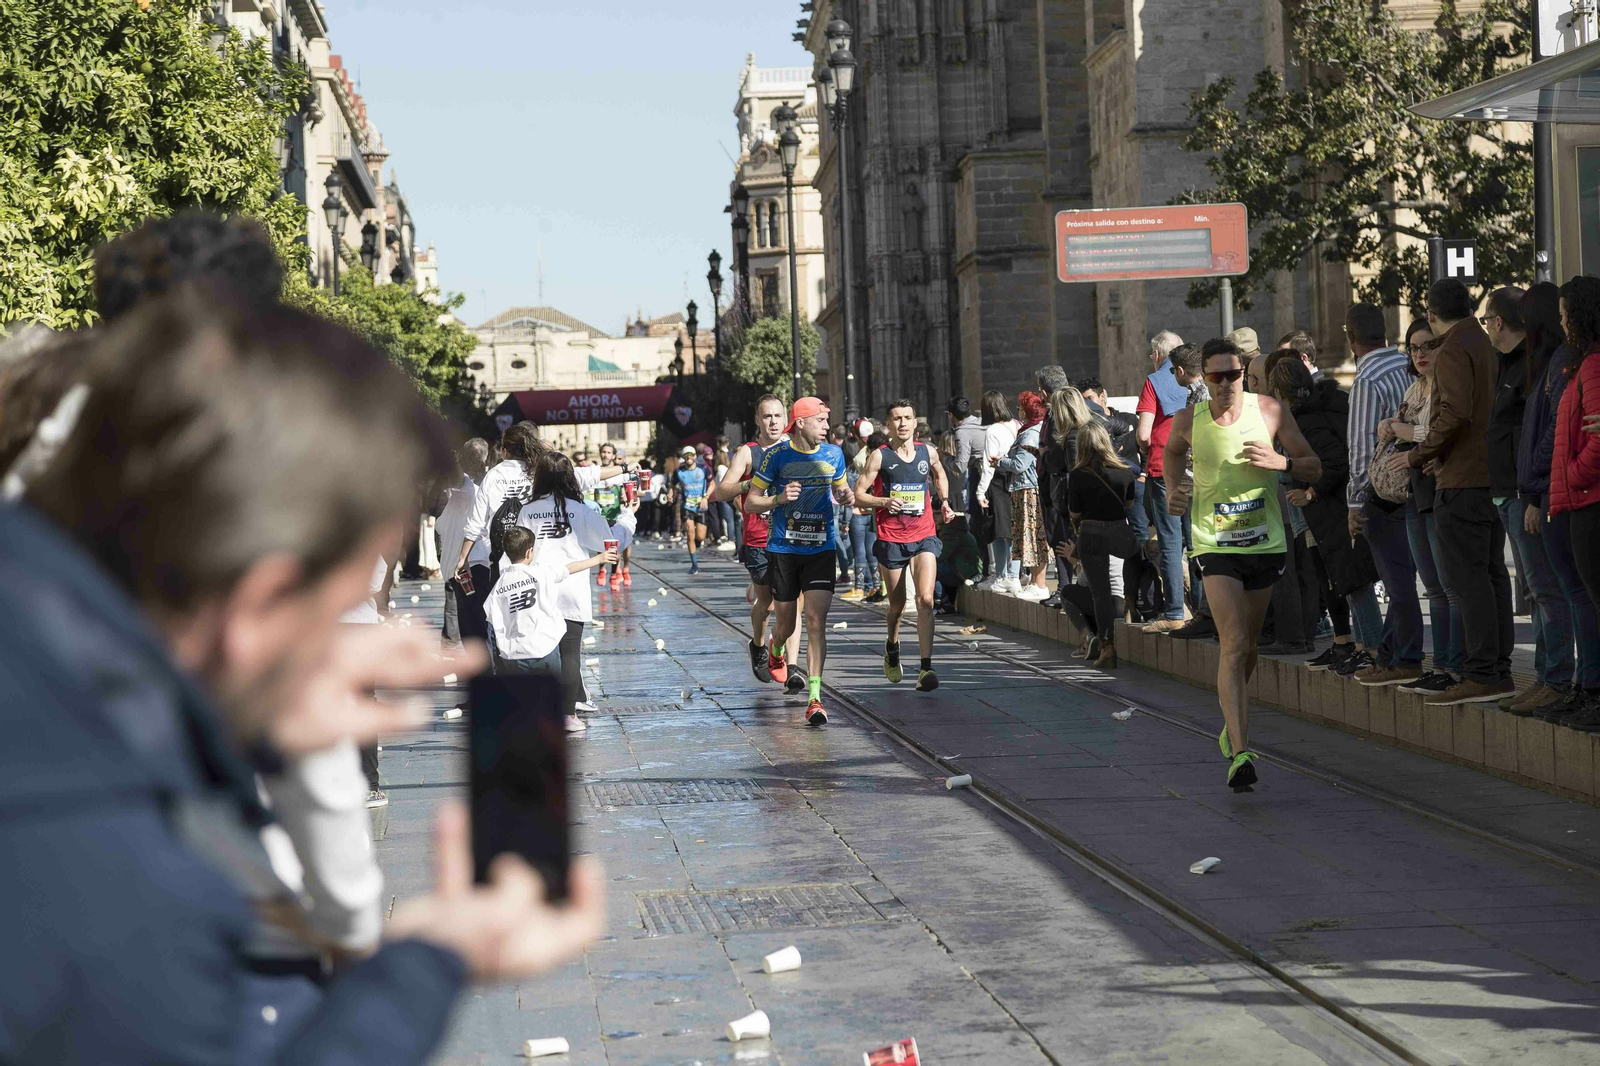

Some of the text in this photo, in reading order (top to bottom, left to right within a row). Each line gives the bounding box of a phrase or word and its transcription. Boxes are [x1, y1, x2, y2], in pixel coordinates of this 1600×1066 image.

[1066, 220, 1094, 228] Próxima
[1095, 218, 1115, 227] salida
[1130, 217, 1156, 225] destino
[1446, 246, 1475, 277] H
[568, 393, 621, 407] AHORA
[546, 405, 644, 421] NO TE RINDAS
[1231, 500, 1259, 512] ZURICH
[1234, 518, 1250, 527] 792
[1231, 529, 1256, 539] IGNACIO
